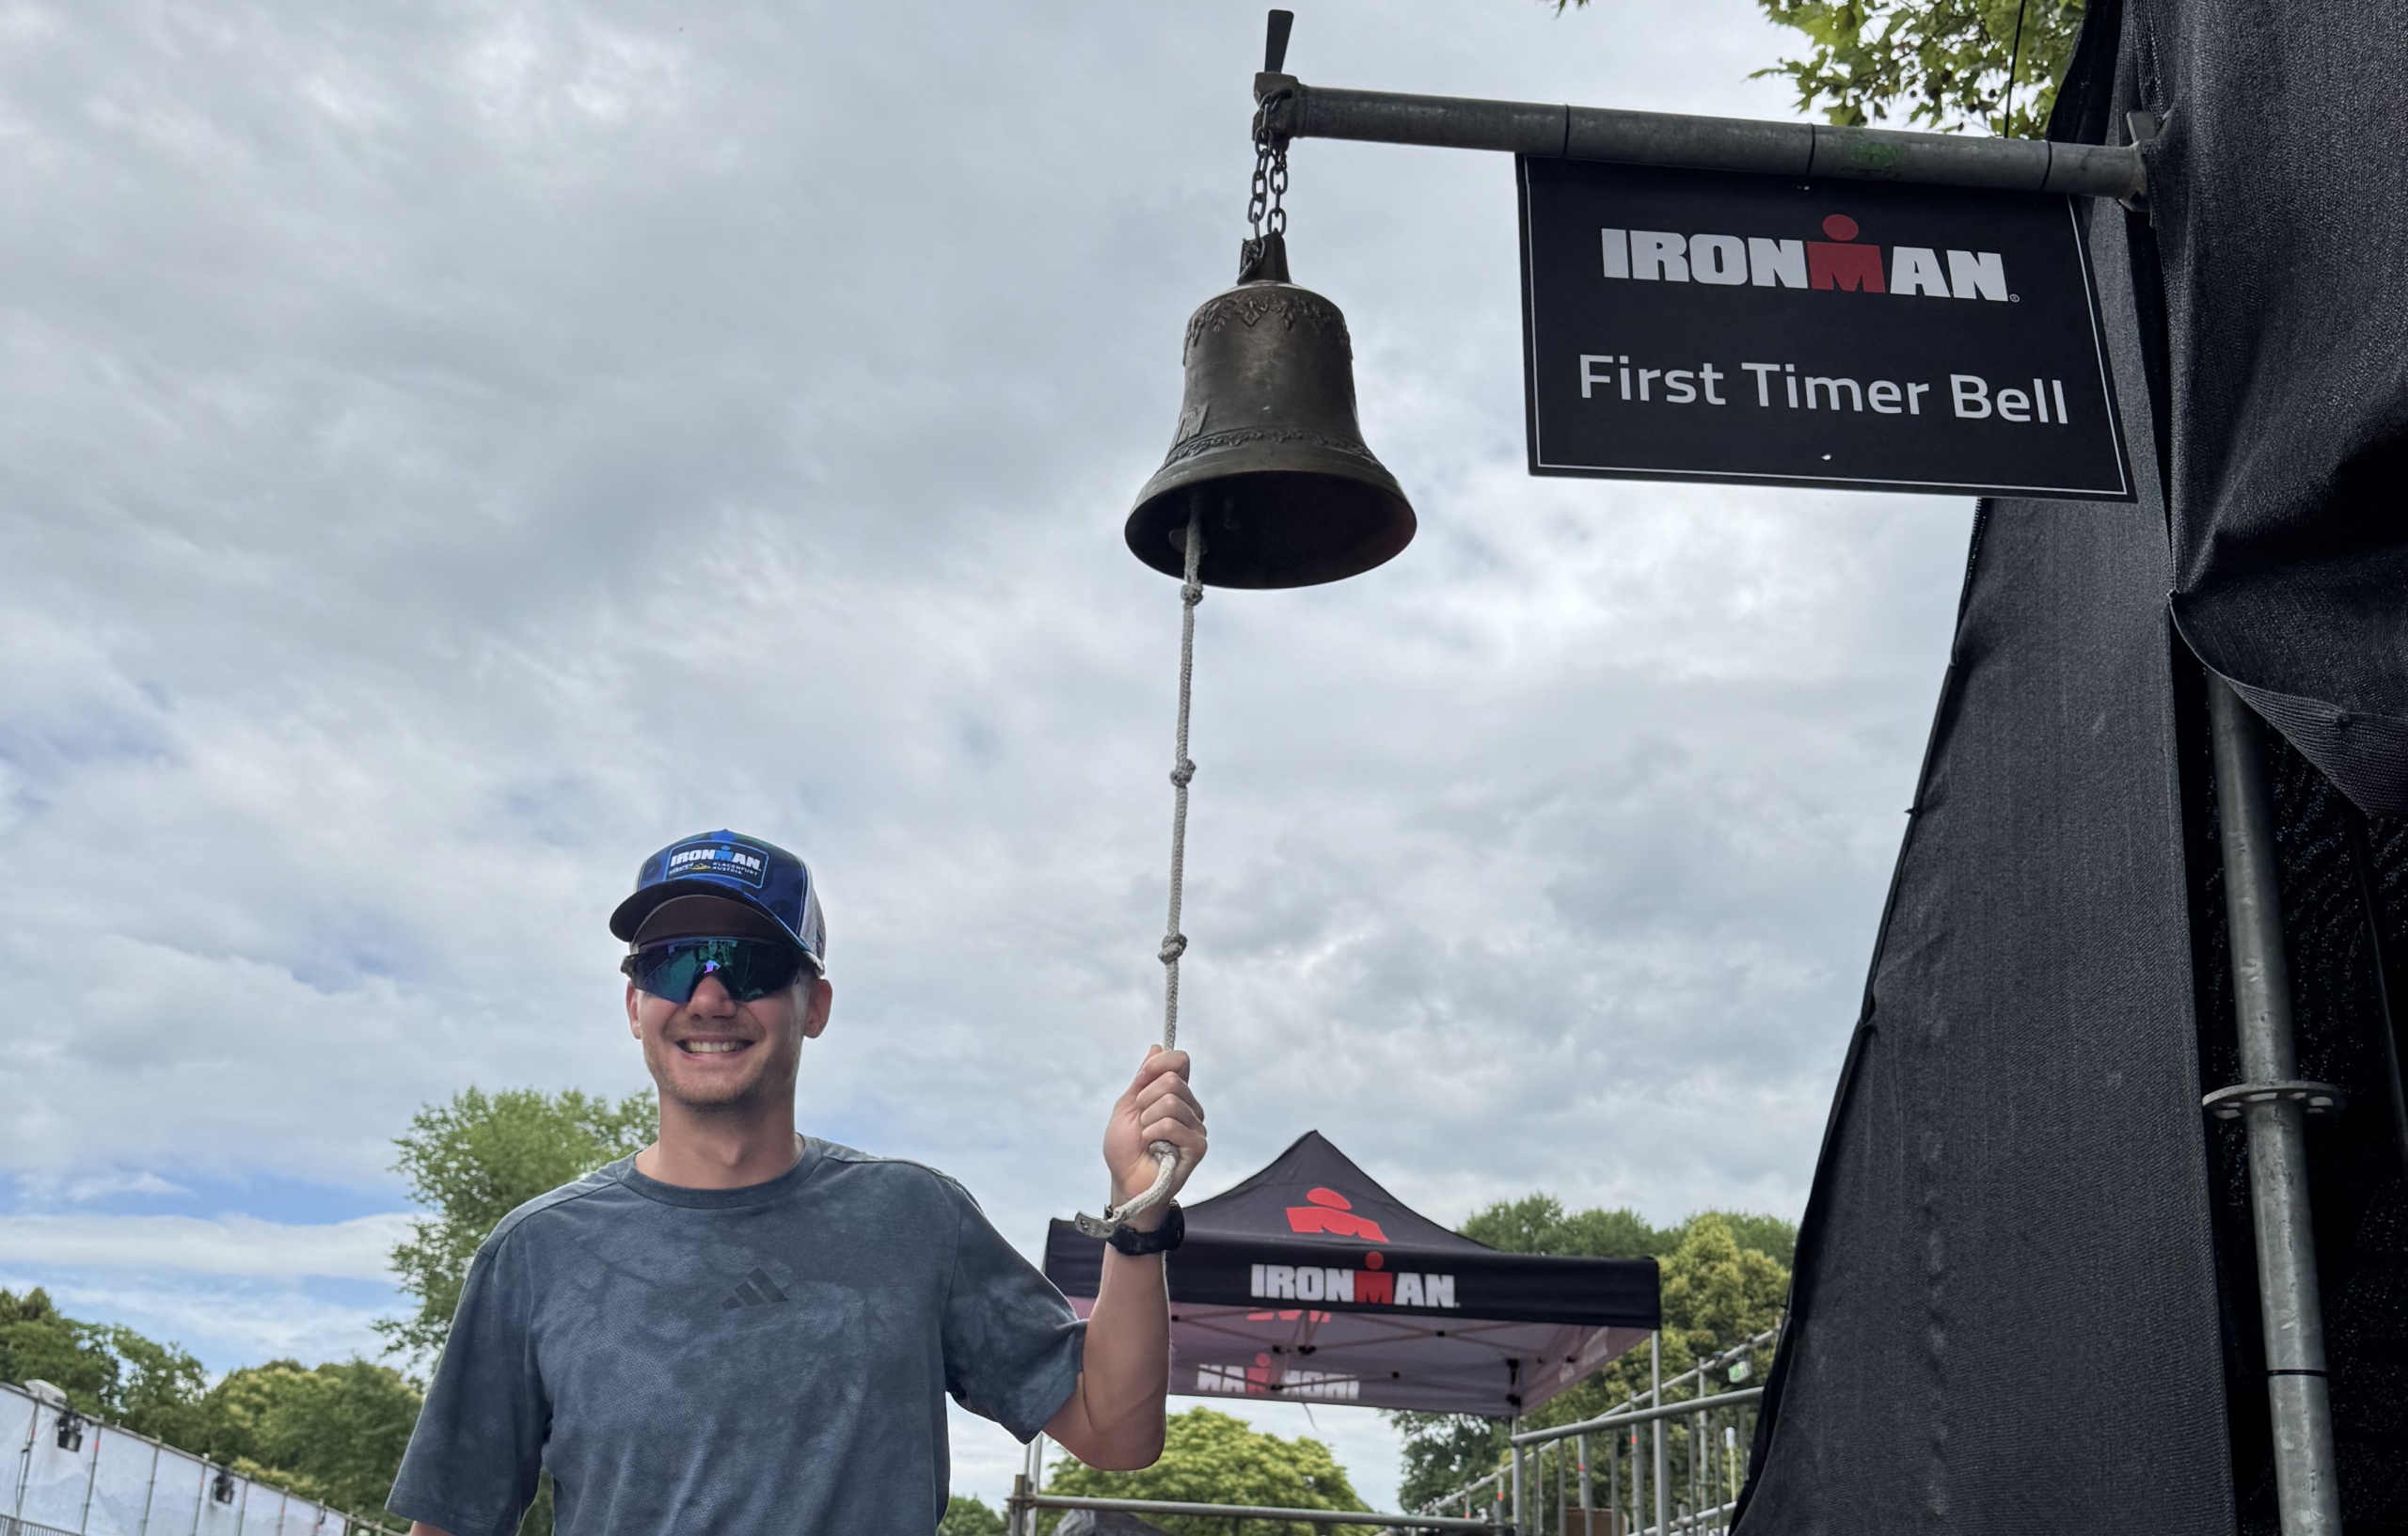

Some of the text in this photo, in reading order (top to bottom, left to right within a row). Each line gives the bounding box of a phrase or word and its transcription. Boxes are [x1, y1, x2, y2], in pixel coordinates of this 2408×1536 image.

[1601, 214, 2008, 302] IRONMAN
[1579, 355, 2068, 424] First Timer Bell
[670, 846, 761, 870] IRONMAN
[712, 865, 742, 875] AUSTRIA
[1251, 1251, 1455, 1308] IRONMAN
